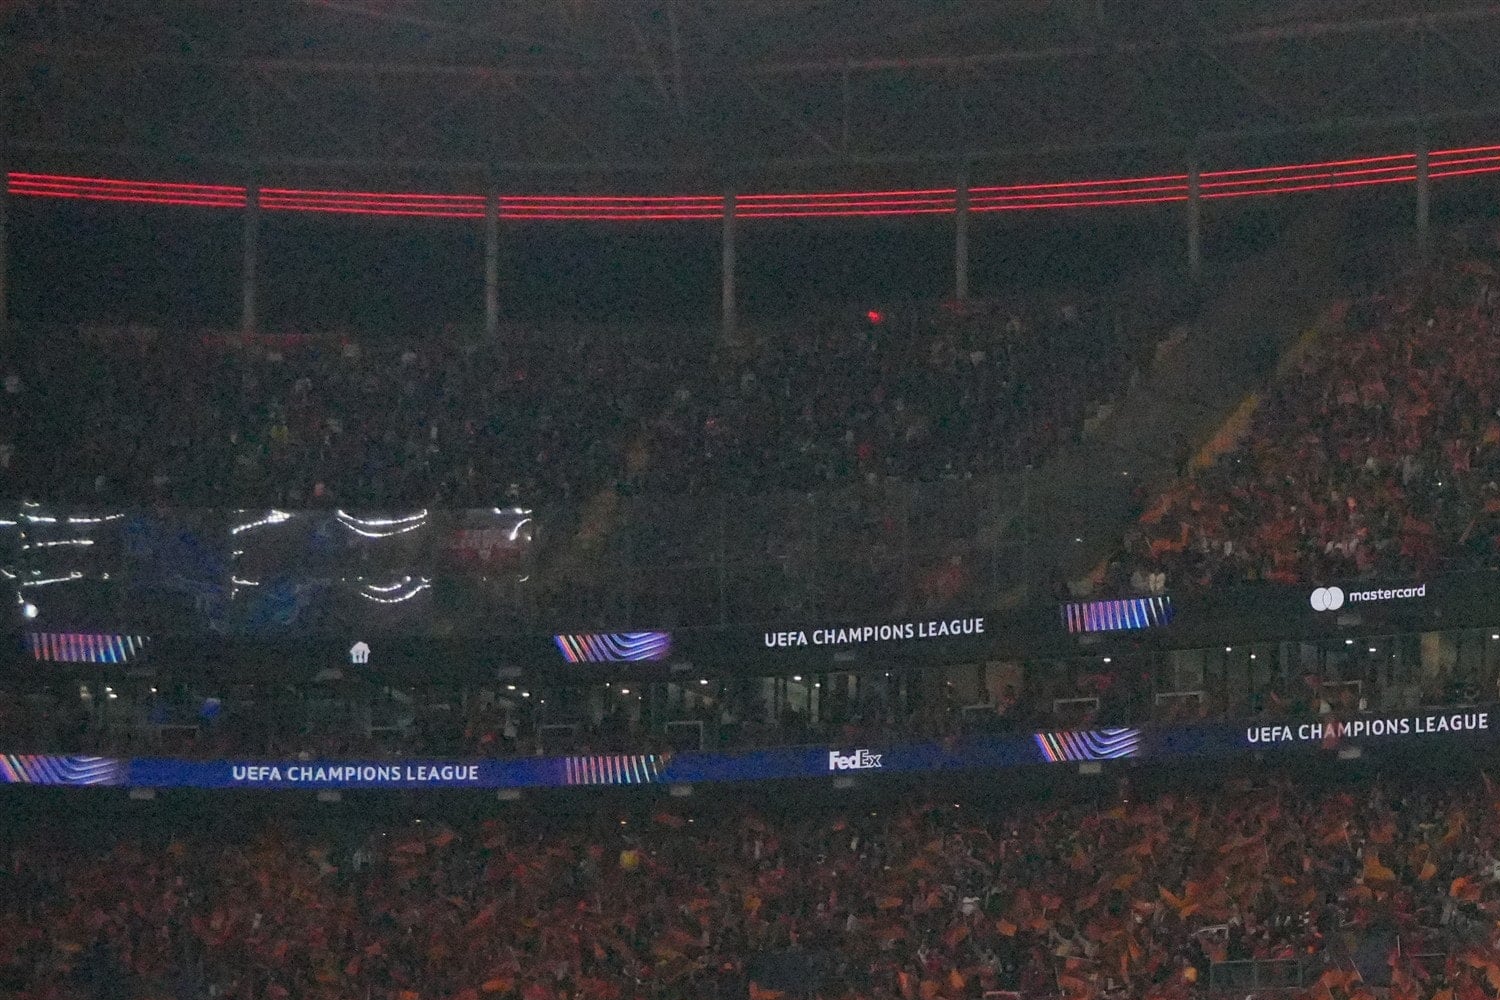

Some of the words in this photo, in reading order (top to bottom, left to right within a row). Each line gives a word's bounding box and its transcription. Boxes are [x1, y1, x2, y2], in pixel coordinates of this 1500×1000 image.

[1349, 584, 1426, 602] mastercard
[764, 631, 808, 647] UEFA
[812, 623, 914, 645] CHAMPIONS
[919, 618, 985, 638] LEAGUE
[1247, 725, 1293, 743] UEFA
[1299, 718, 1410, 741] CHAMPIONS
[1415, 713, 1488, 733] LEAGUE
[829, 749, 882, 770] FedEx
[232, 766, 281, 781] UEFA
[288, 766, 401, 781] CHAMPIONS
[406, 765, 479, 780] LEAGUE
